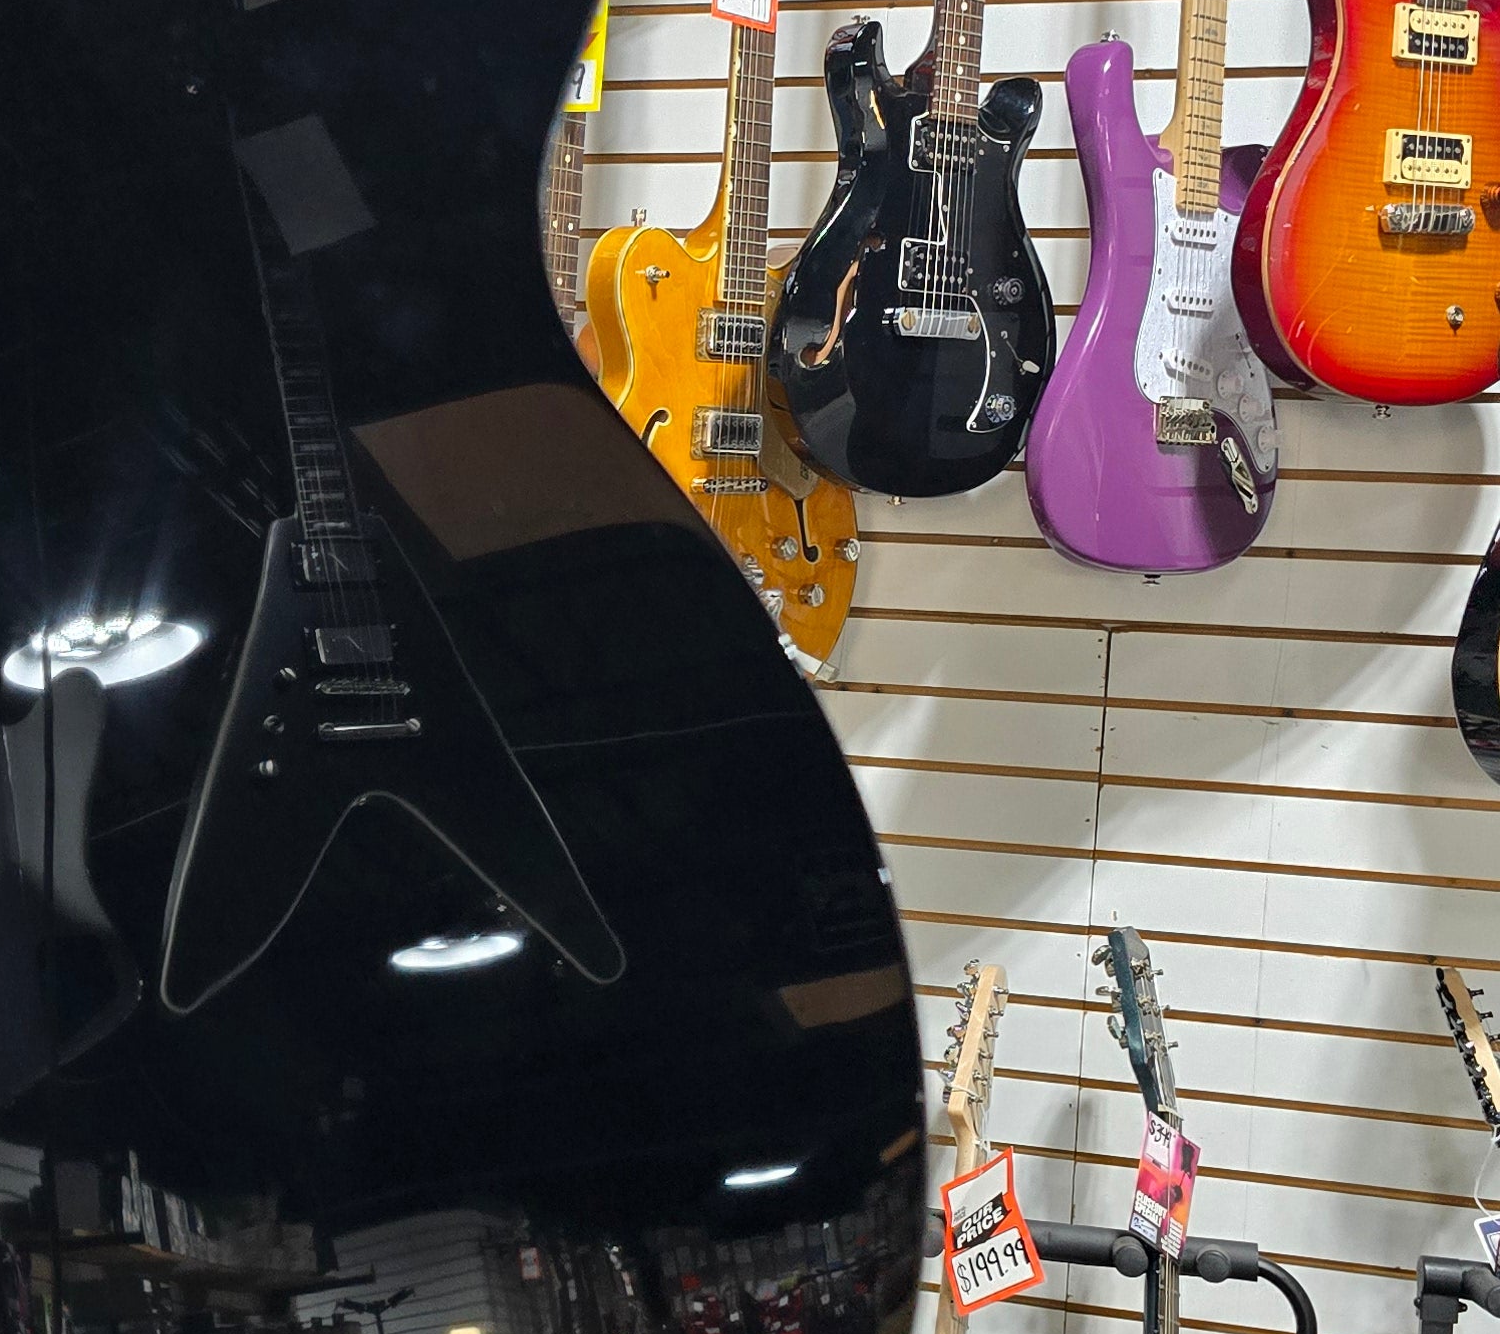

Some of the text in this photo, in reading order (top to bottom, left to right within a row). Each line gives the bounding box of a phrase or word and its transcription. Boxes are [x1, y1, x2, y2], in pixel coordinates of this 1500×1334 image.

[956, 1206, 1005, 1249] PRICE
[961, 1201, 993, 1232] OUR
[956, 1237, 1031, 1296] $199.99
